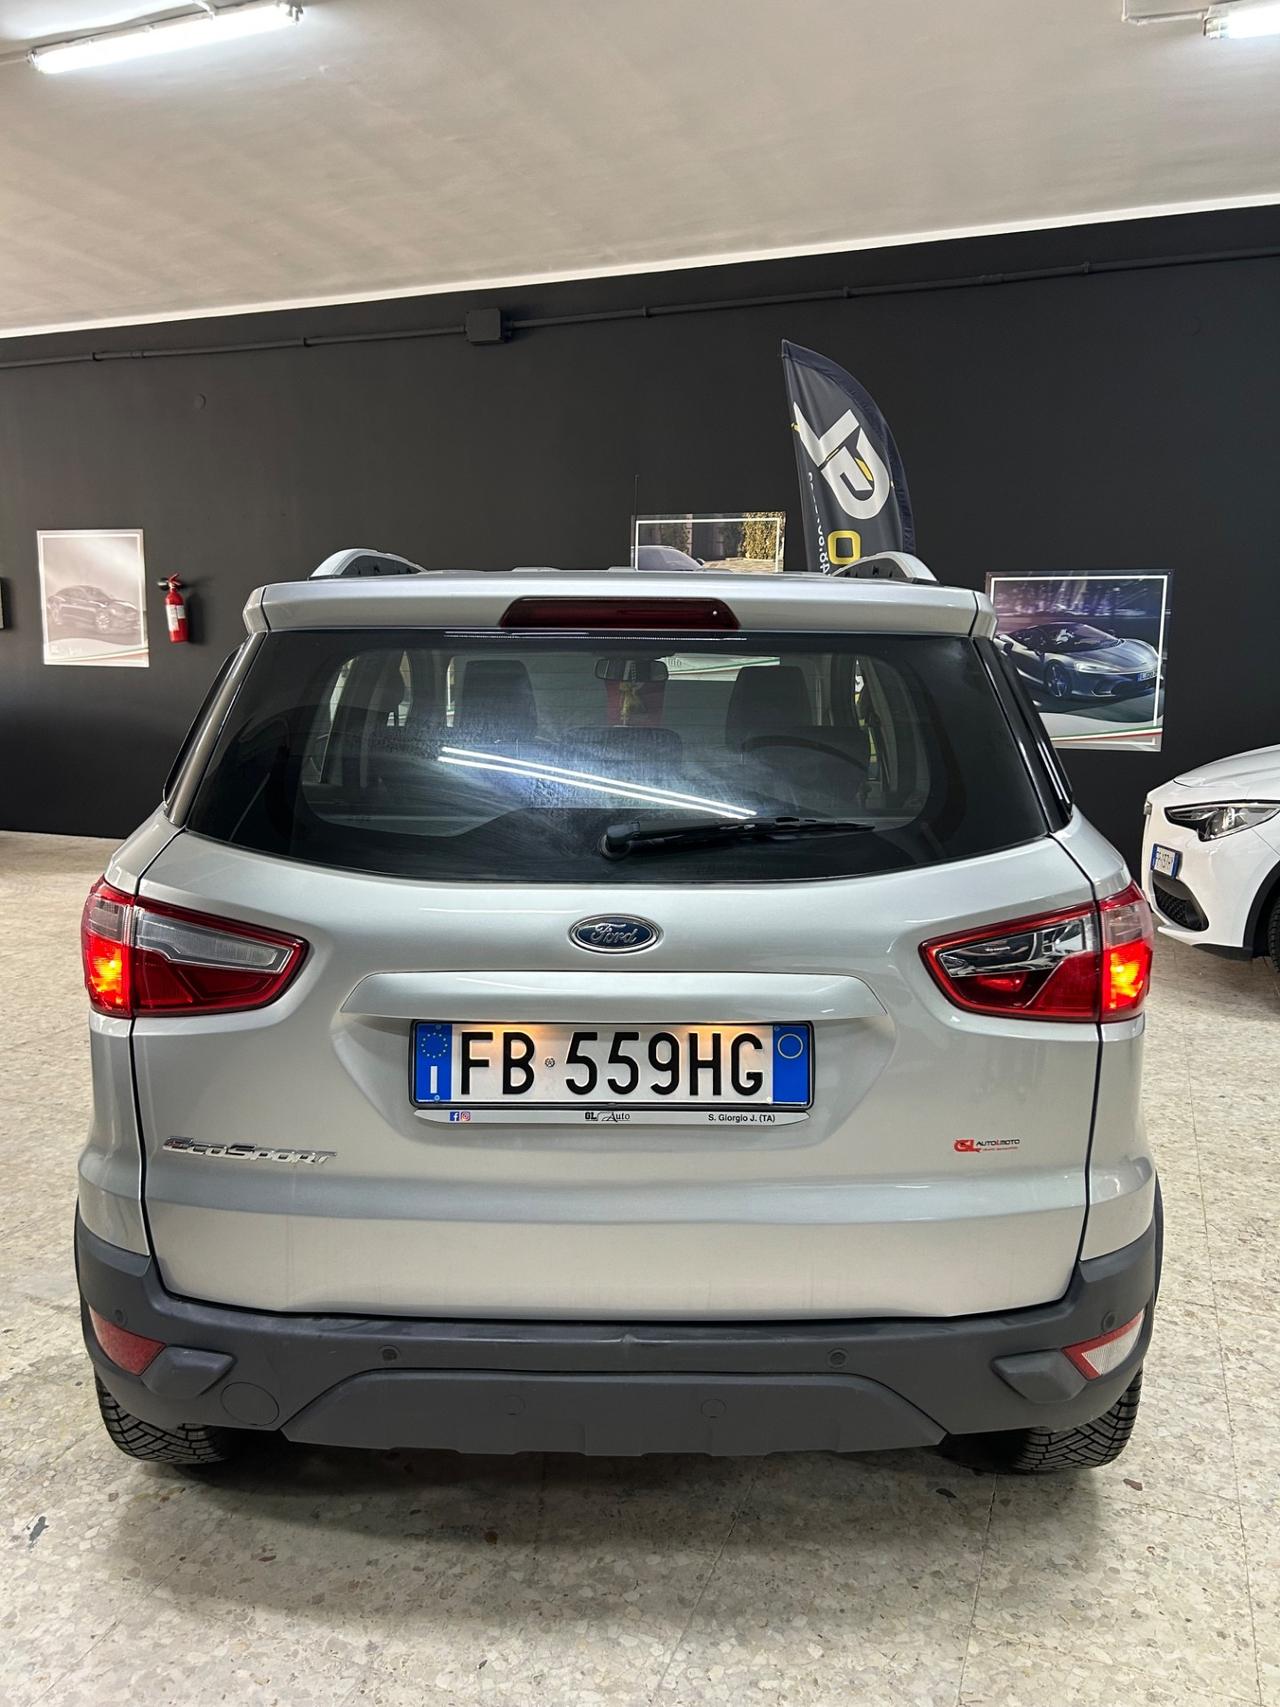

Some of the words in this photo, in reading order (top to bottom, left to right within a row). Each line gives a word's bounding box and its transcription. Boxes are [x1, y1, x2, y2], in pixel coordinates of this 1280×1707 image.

[590, 922, 638, 943] Ford
[461, 1031, 535, 1095] FB
[565, 1031, 763, 1096] 559HG
[585, 1112, 597, 1120] GL
[607, 1112, 630, 1122] Auto
[718, 1114, 748, 1123] Giorgio
[750, 1114, 758, 1122] J.
[759, 1114, 776, 1123] (TA)
